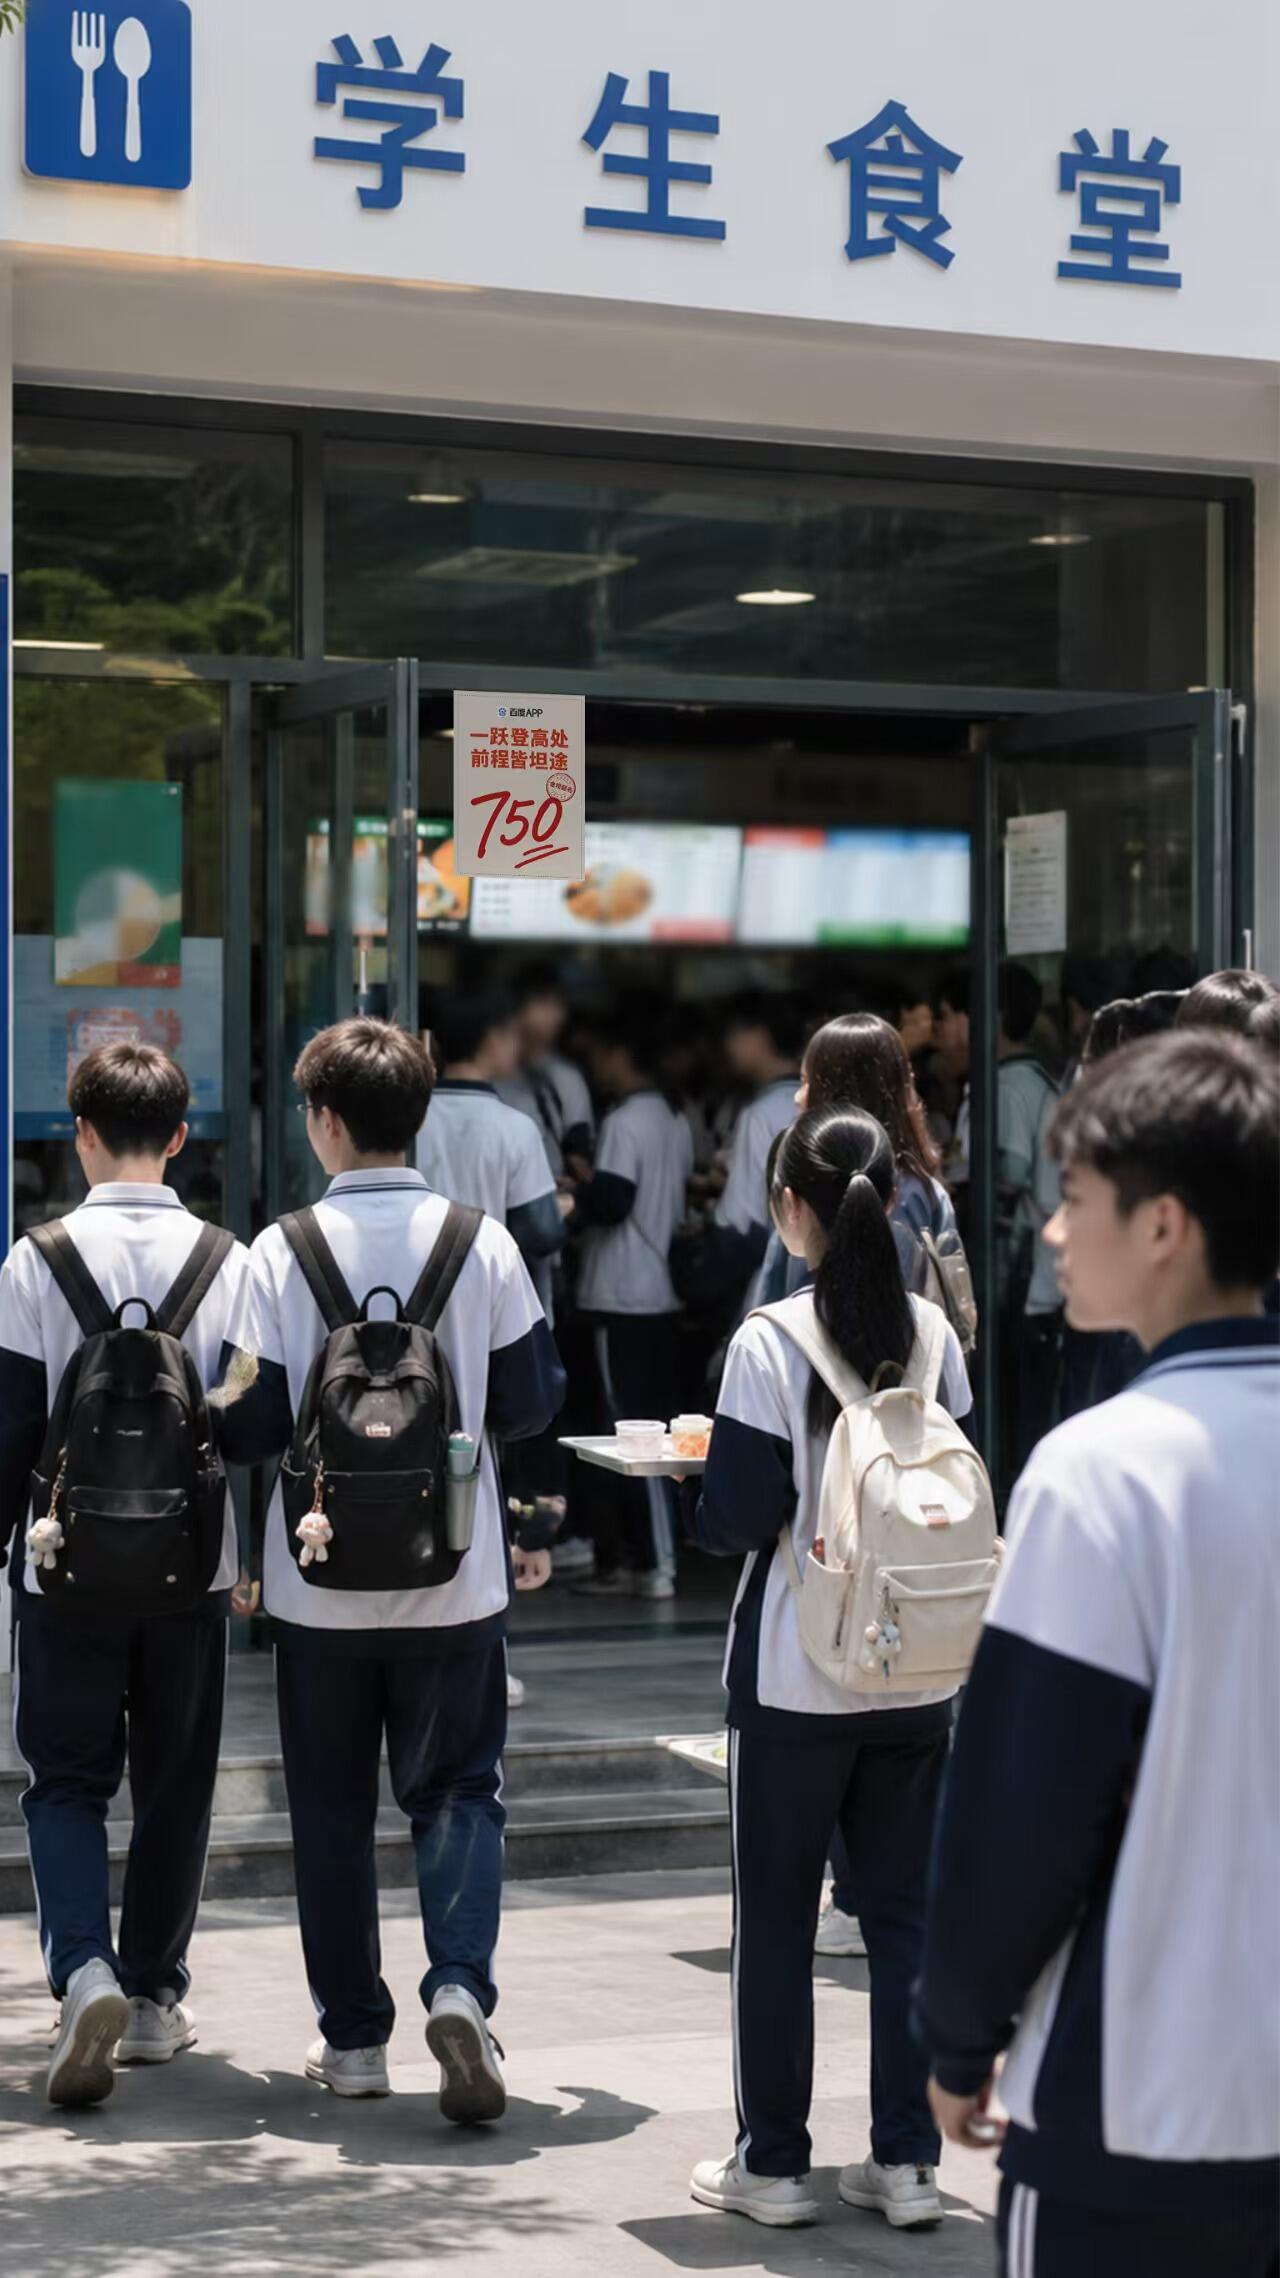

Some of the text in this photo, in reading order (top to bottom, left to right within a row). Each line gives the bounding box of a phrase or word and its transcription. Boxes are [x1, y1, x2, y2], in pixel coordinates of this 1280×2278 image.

[314, 34, 1182, 289] 学生食堂
[470, 727, 569, 749] 一跃登高处
[471, 749, 569, 772] 前程皆坦途
[471, 791, 563, 859] 750
